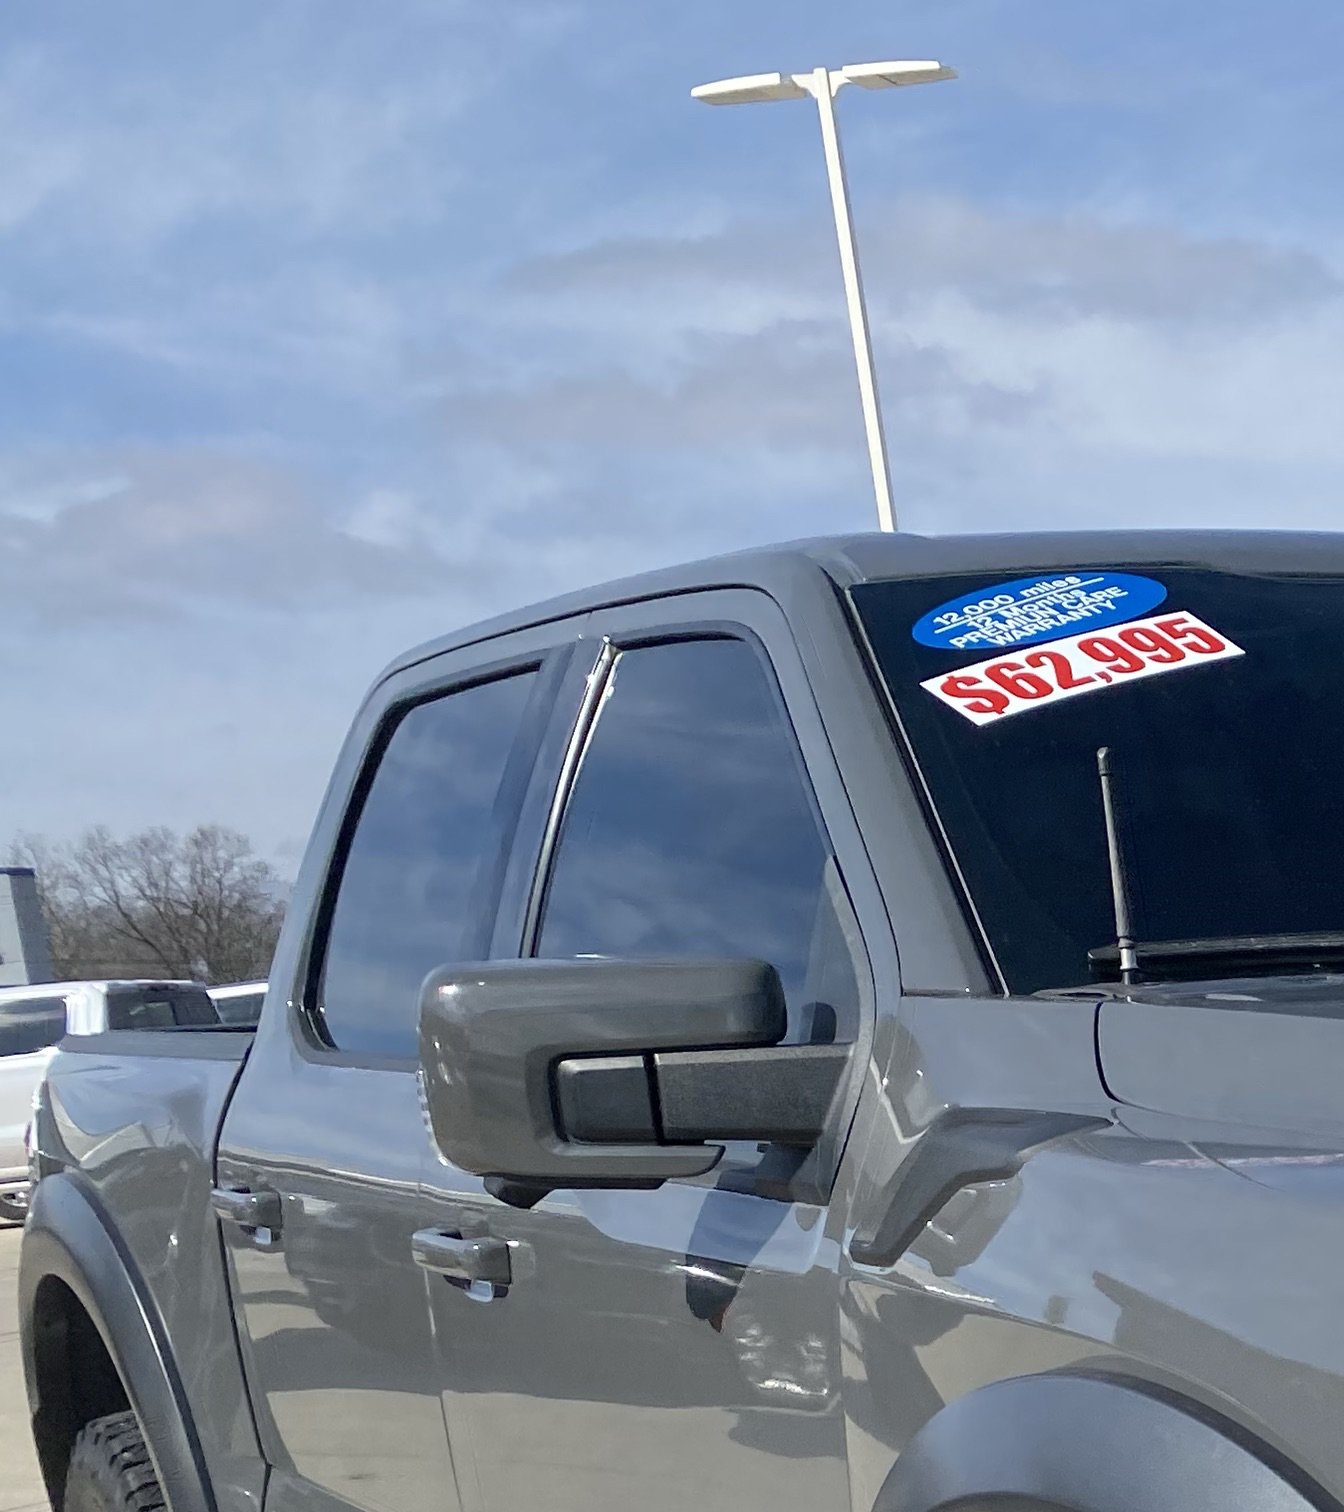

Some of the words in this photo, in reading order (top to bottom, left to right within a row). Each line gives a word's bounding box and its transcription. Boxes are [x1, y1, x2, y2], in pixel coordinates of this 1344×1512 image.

[933, 594, 1015, 626] 12,000
[1019, 576, 1081, 598] miles
[967, 615, 993, 629] 12
[999, 588, 1087, 619] Months
[1061, 586, 1129, 611] CARE
[986, 599, 1117, 646] WARRANTY
[940, 617, 1226, 715] $62,995
